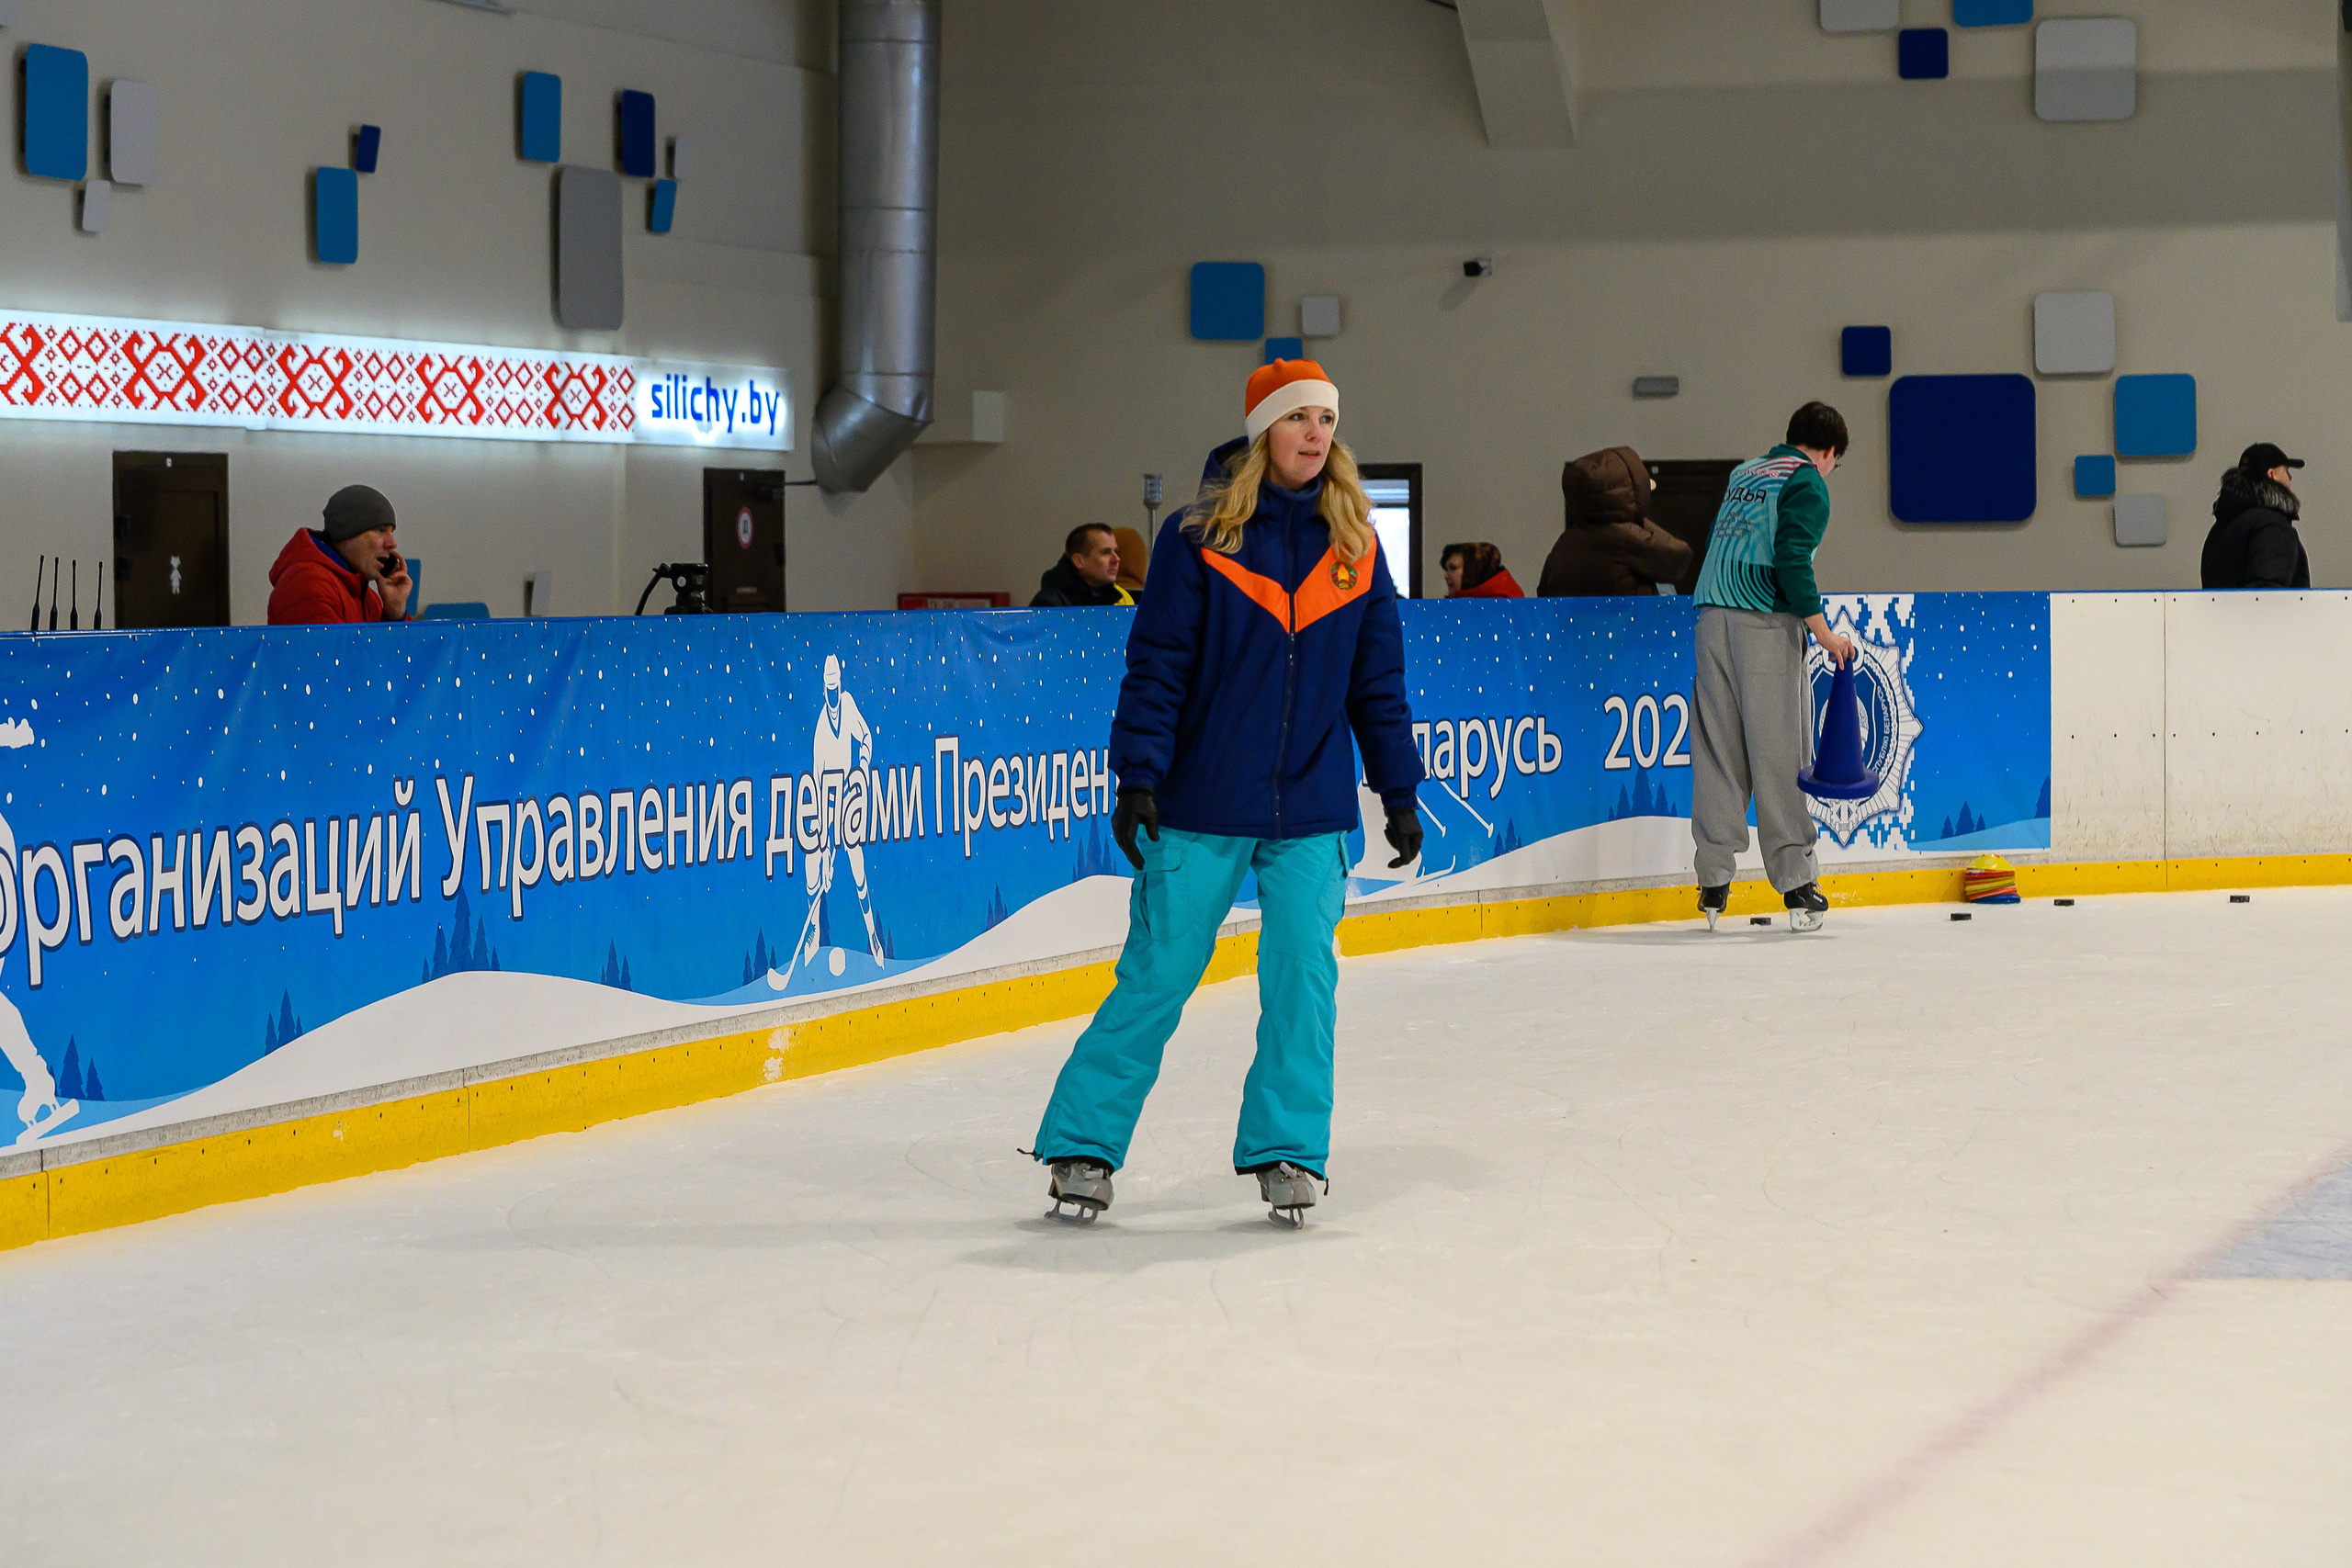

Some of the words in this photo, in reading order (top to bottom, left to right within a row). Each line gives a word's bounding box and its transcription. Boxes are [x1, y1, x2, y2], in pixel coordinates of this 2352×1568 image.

[651, 373, 780, 435] silichy.by
[1726, 486, 1767, 503] УДЬЯ
[435, 774, 754, 918] Управления
[766, 764, 925, 878] делами
[934, 736, 1114, 857] Президен
[1411, 716, 1563, 799] ларусь
[1603, 694, 1690, 770] 202
